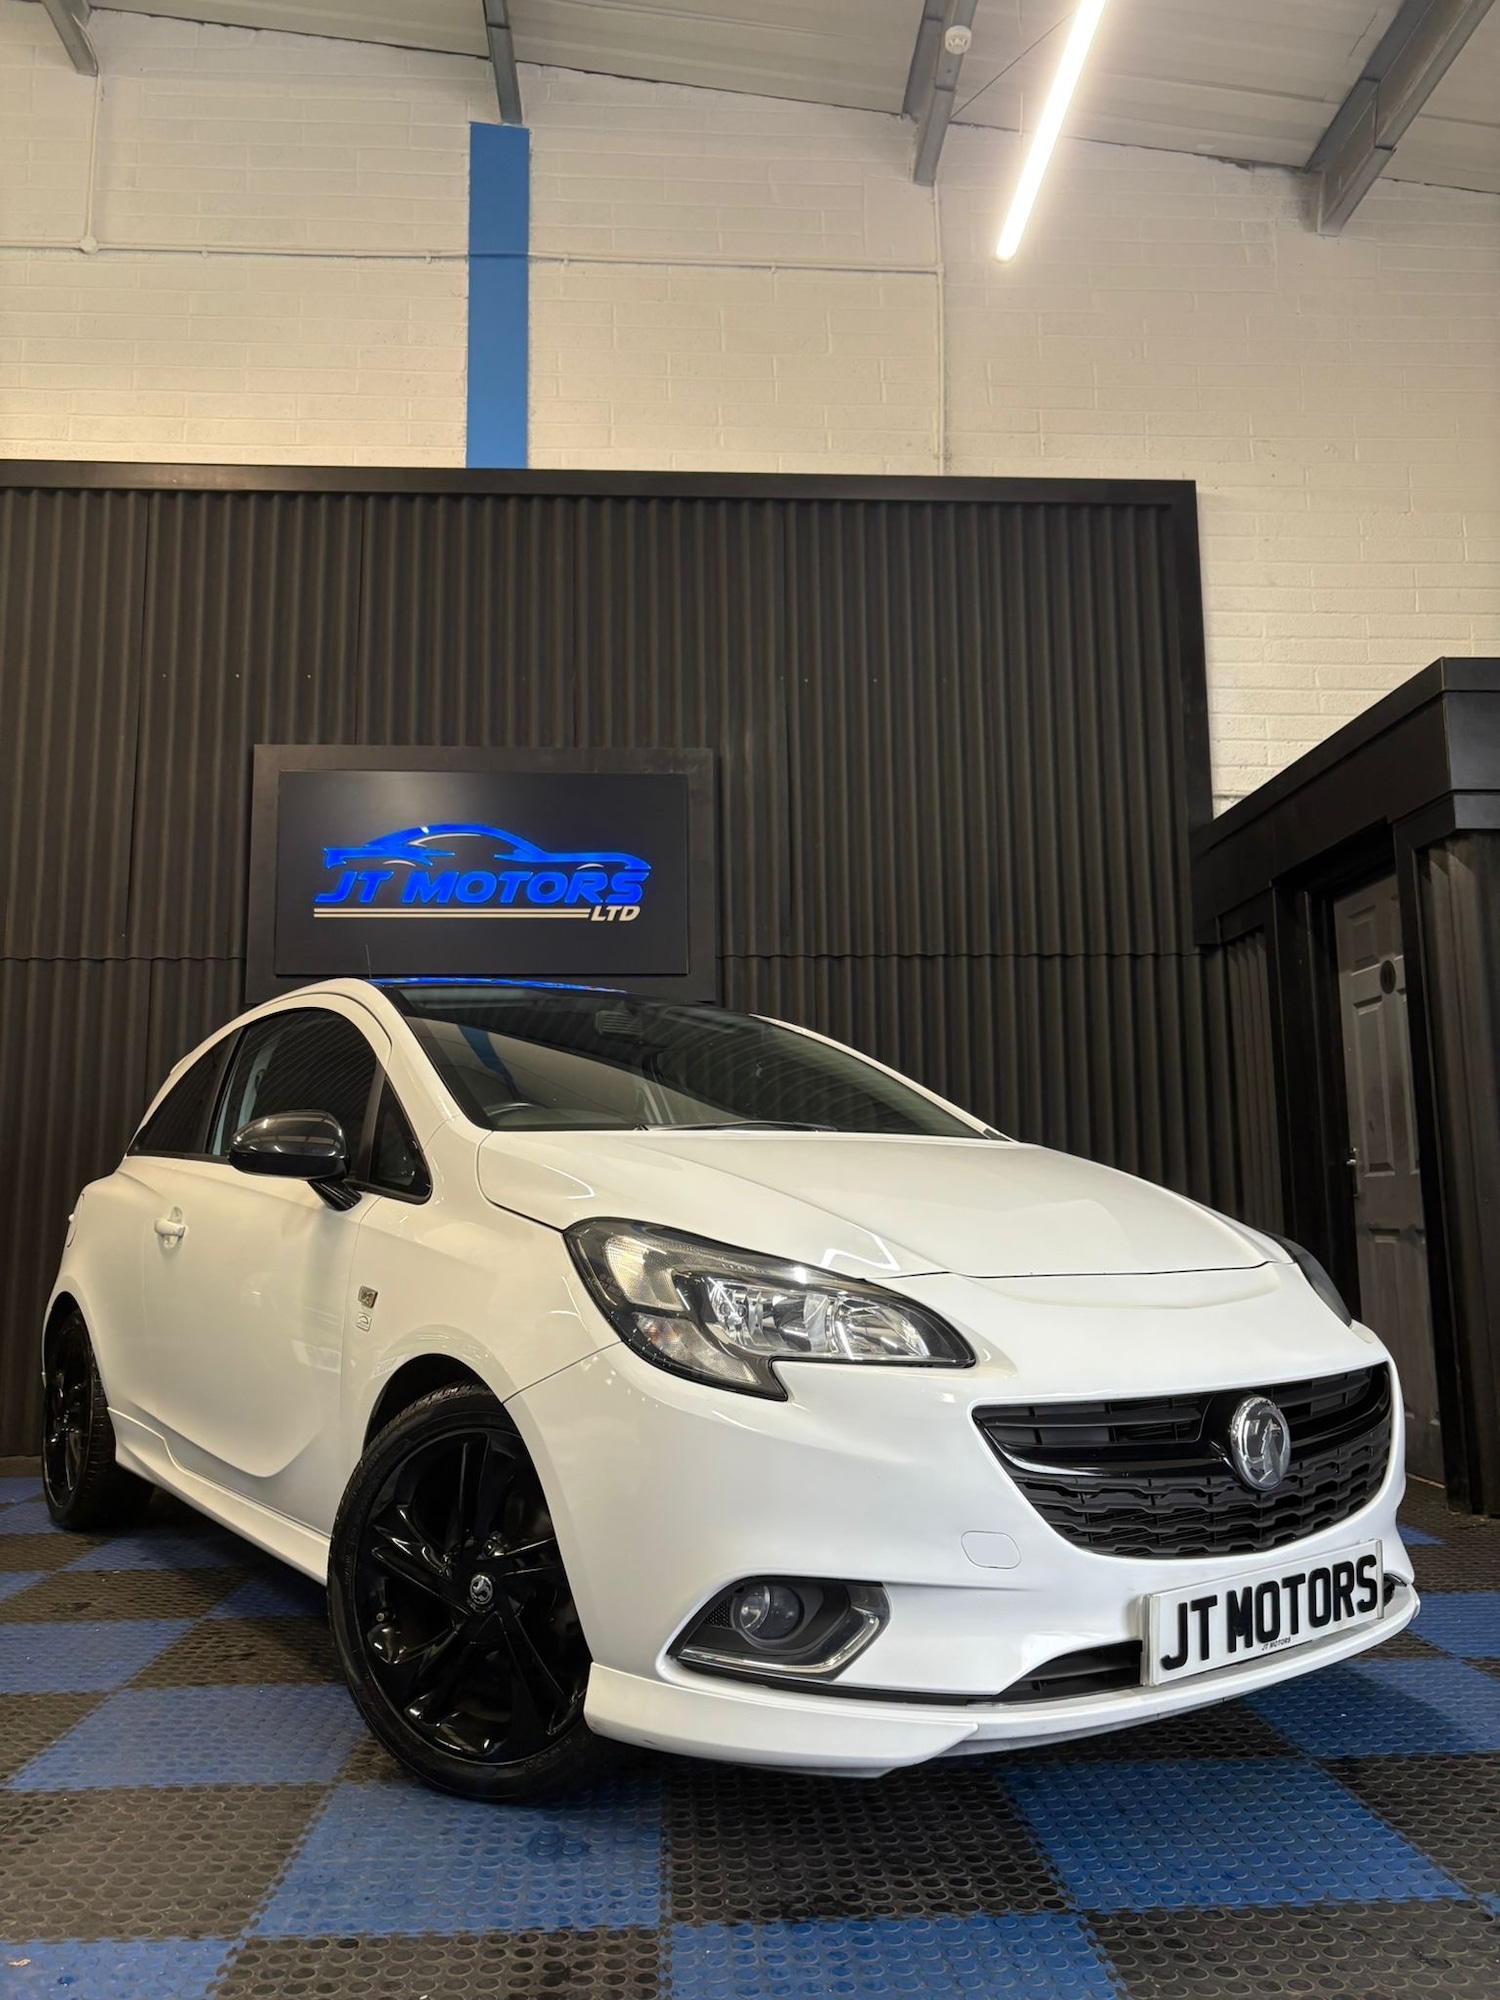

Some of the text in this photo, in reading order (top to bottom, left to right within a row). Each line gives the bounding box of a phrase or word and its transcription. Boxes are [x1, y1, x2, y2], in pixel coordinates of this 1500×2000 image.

[313, 870, 650, 904] JT MOTORS
[590, 904, 641, 922] LTD
[1160, 1554, 1378, 1671] JT MOTORS
[1261, 1636, 1292, 1651] JT MOTORS
